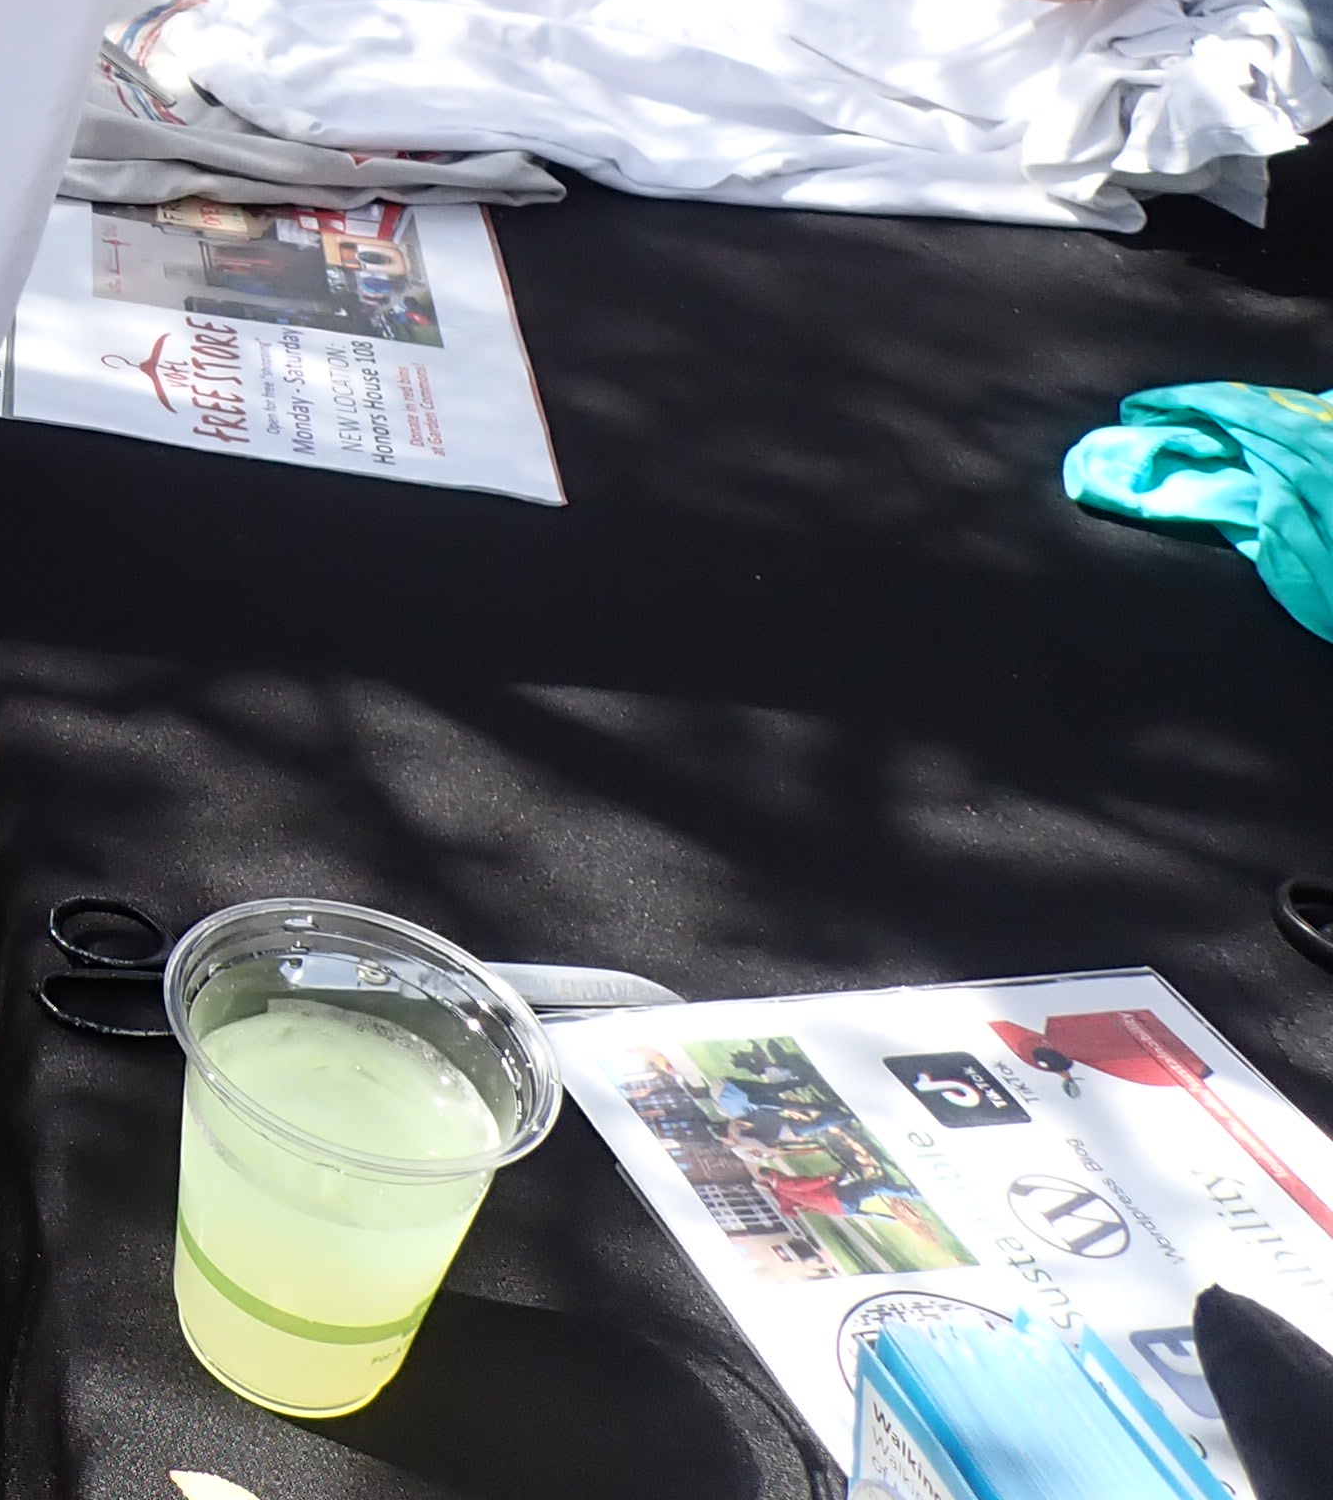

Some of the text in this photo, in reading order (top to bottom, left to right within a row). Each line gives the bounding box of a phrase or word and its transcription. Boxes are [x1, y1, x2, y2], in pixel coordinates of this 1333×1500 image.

[185, 316, 250, 443] FREE STORE
[277, 326, 306, 386] Saturday
[261, 381, 276, 398] free
[324, 343, 365, 453] NEW LOCATION:
[351, 340, 397, 466] Honors House 108
[397, 385, 415, 402] red
[286, 396, 316, 456] Monday
[407, 414, 425, 447] Donate
[423, 411, 443, 445] Garden
[1066, 1137, 1185, 1265] Wordpress Blog
